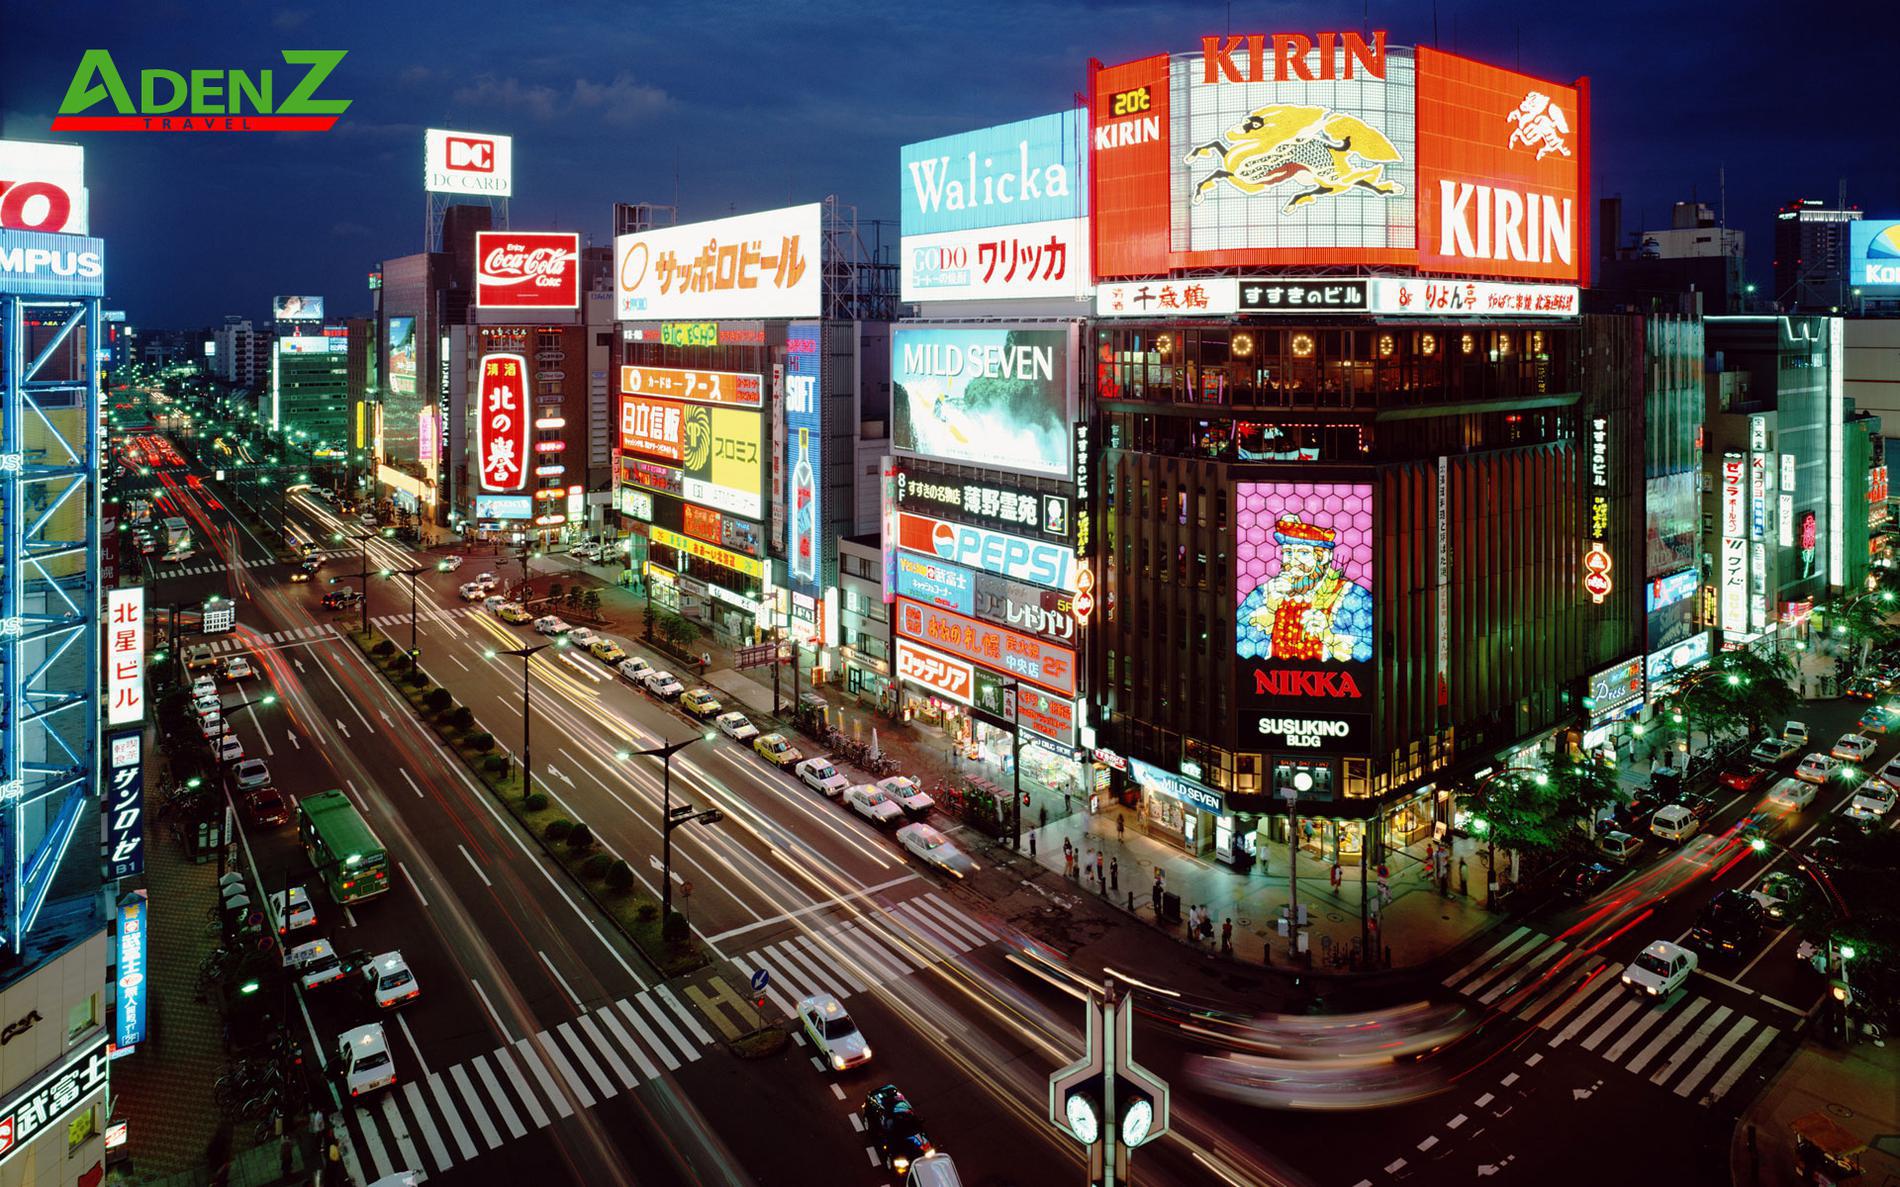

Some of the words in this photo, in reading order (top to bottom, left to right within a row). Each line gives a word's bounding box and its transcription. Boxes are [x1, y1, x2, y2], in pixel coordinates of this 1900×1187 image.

[1202, 30, 1386, 84] KIRIN
[1096, 115, 1160, 150] KIRIN
[450, 140, 491, 169] DC
[433, 173, 457, 187] DC
[462, 176, 507, 191] CARD
[908, 140, 1069, 214] Walicka
[0, 181, 71, 233] O
[1439, 180, 1572, 266] KIRIN
[655, 235, 807, 296] サッポロビール
[978, 235, 1066, 284] ワリッカ
[535, 275, 562, 287] Coke
[1133, 283, 1210, 311] 千歳鶴
[1245, 286, 1361, 304] すすきのビル
[1399, 286, 1413, 307] 8F
[687, 323, 716, 347] ECHO
[904, 343, 964, 377] MILD
[965, 344, 1053, 381] SEVEN
[622, 402, 681, 443] 日立信販
[1077, 426, 1088, 500] すすきのビル
[1726, 461, 1742, 496] ゼブラ
[957, 527, 1070, 589] PEPSI
[1727, 556, 1744, 586] ワイド
[1057, 599, 1073, 613] 5F
[114, 602, 140, 709] 北星ビル
[900, 648, 967, 692] ロッテリア
[1043, 655, 1068, 677] 2F
[1253, 668, 1362, 698] NIKKA
[1595, 680, 1626, 702] Dress
[1259, 718, 1350, 738] SUSUKINO
[1286, 734, 1322, 748] BLDG
[1162, 777, 1187, 795] MILD
[1187, 788, 1219, 809] SEVEN
[112, 767, 141, 862] サンローゼ
[115, 861, 136, 875] B1
[17, 1054, 106, 1140] 武富士
